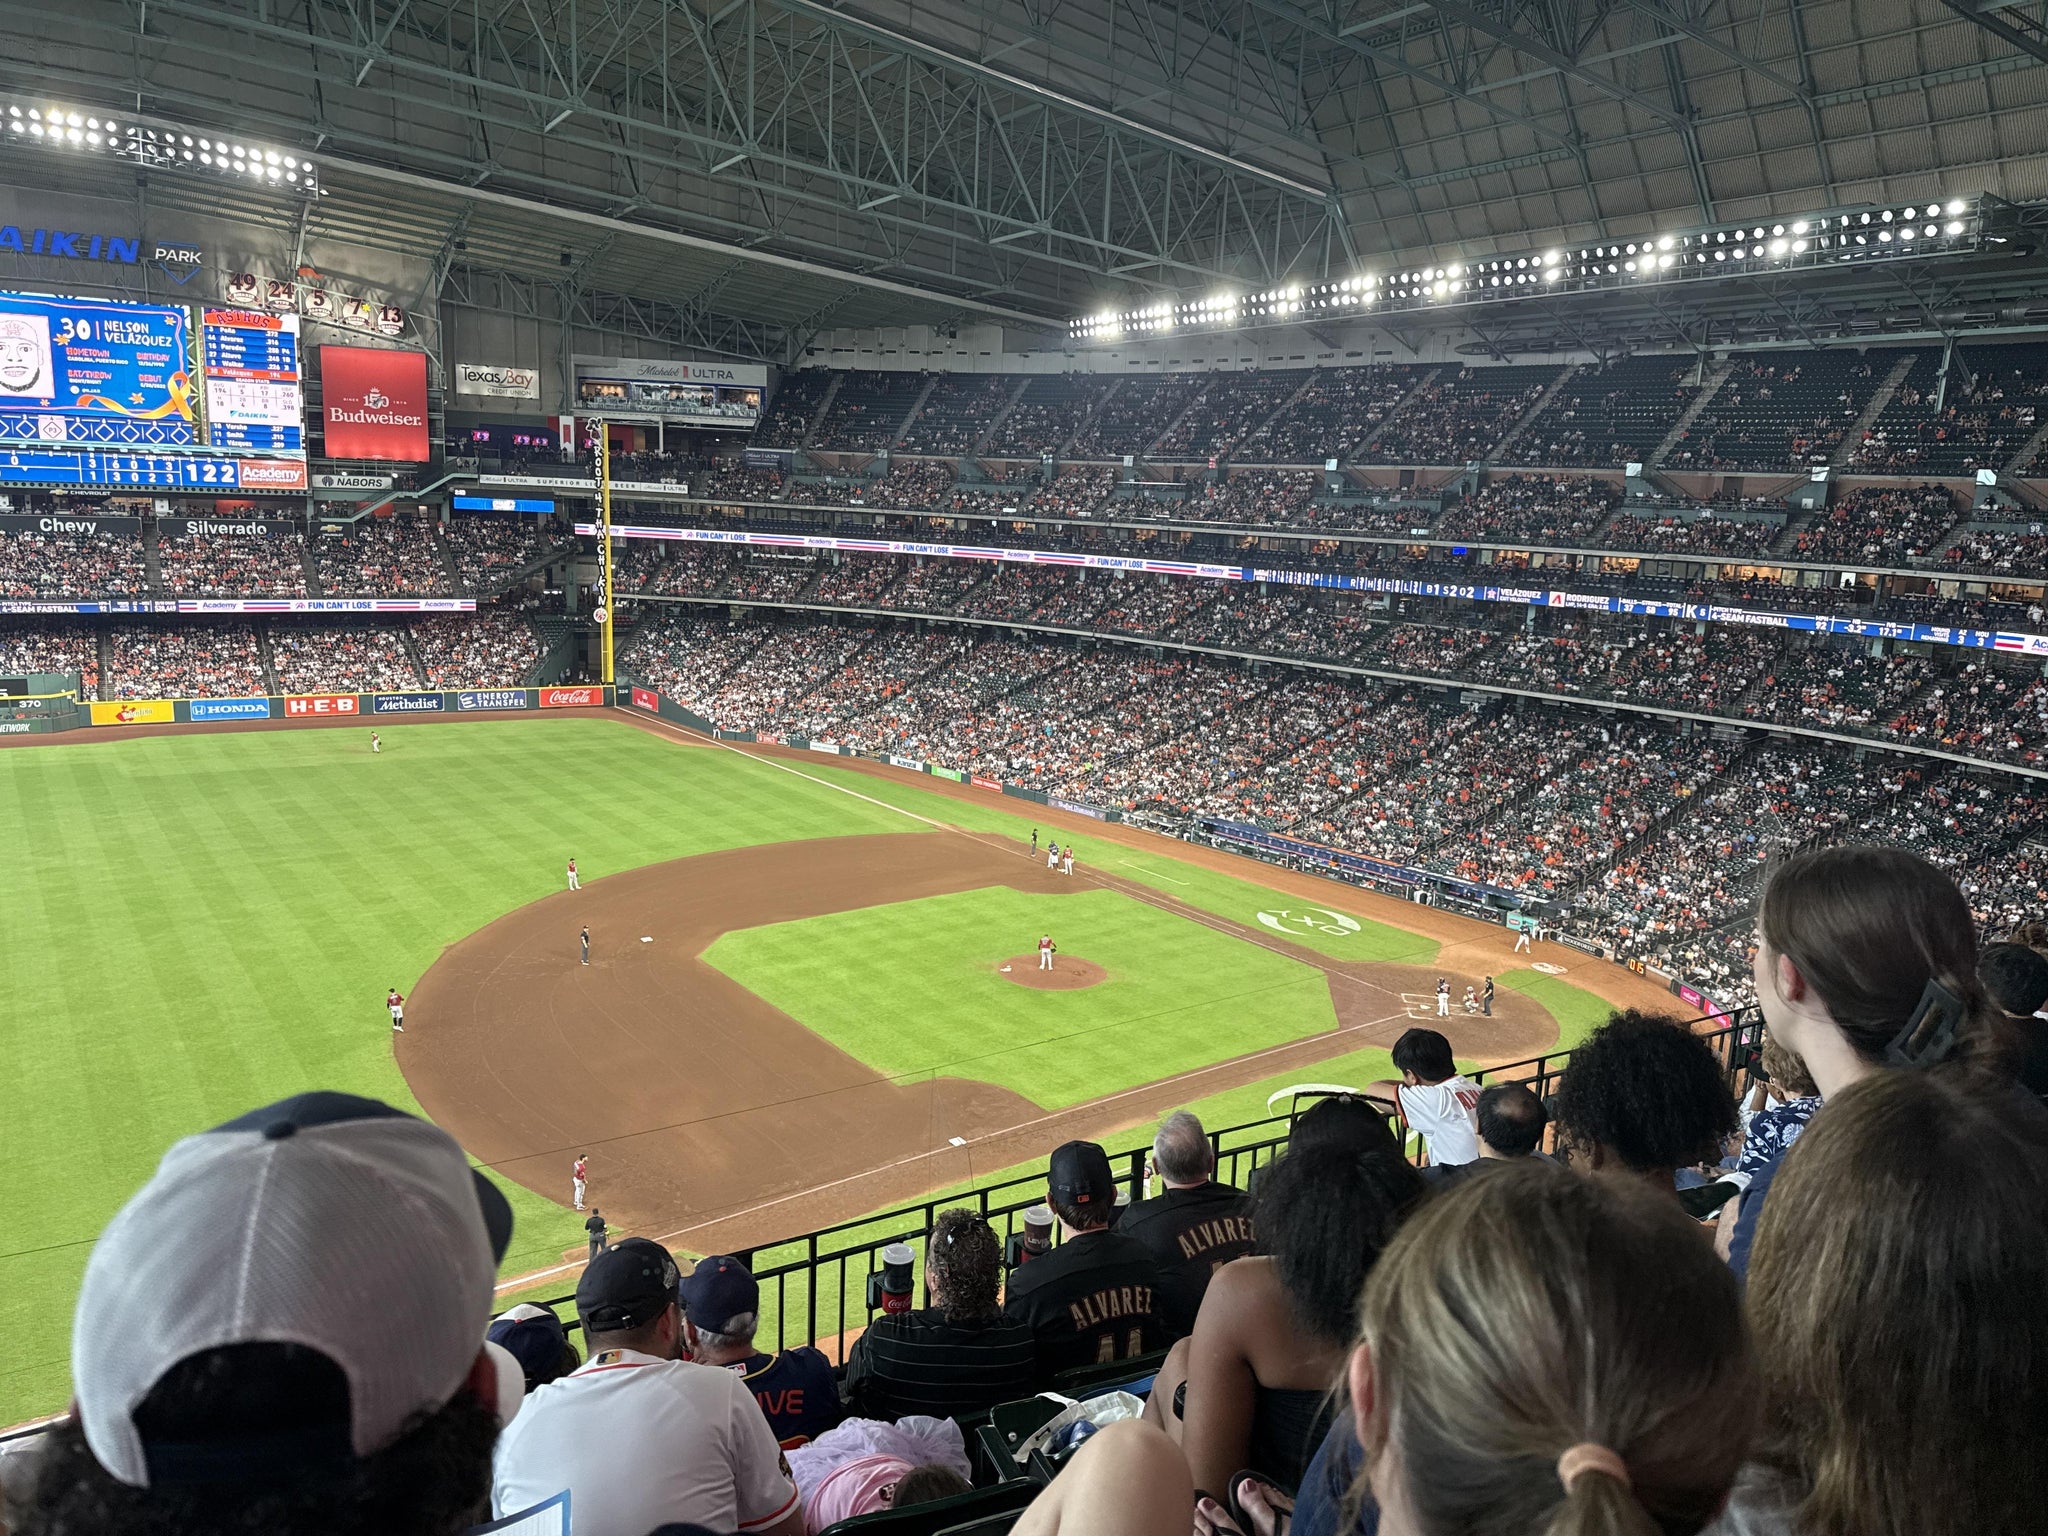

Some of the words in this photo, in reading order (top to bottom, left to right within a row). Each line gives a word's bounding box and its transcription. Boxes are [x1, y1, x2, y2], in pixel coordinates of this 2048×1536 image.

[155, 248, 202, 264] PARK
[230, 273, 256, 291] 49
[268, 281, 294, 300] 24
[314, 290, 325, 306] 5
[350, 299, 362, 314] 7
[216, 311, 270, 328] ASTROS
[380, 306, 402, 324] 13
[60, 318, 90, 340] 30
[104, 320, 149, 334] NELSON
[104, 332, 172, 347] VELÁZQUEZ
[66, 347, 110, 358] HOMETOWN
[136, 352, 170, 361] BIRTHDAY
[68, 370, 112, 380] BAT/THROW
[139, 374, 162, 382] DEBUT
[461, 366, 500, 382] Texas
[503, 369, 533, 389] Bay
[637, 364, 679, 378] Michelob
[692, 370, 734, 380] ULTRA
[487, 387, 508, 395] CREDIT
[11, 455, 19, 465] 0
[89, 459, 96, 468] 3
[112, 460, 120, 470] 6
[131, 461, 138, 470] 0
[150, 461, 155, 470] 1
[166, 462, 173, 471] 3
[594, 446, 603, 487] ROOT
[90, 471, 96, 480] 1
[113, 472, 121, 481] 3
[131, 472, 139, 482] 0
[149, 473, 156, 483] 2
[166, 474, 174, 483] 3
[186, 464, 198, 482] 1
[203, 464, 217, 482] 2
[221, 464, 235, 483] 2
[242, 467, 300, 482] Academy
[337, 478, 383, 488] NABORS
[595, 492, 602, 504] 4
[39, 518, 96, 535] Chevy
[187, 521, 267, 535] Silverado
[808, 538, 832, 546] Academy
[1007, 551, 1030, 559] Academy
[1109, 559, 1127, 567] CAN'T
[597, 545, 606, 606] CHIKIN
[1200, 566, 1224, 575] Academy
[1500, 588, 1541, 599] VELÁZQUEZ
[1566, 594, 1609, 605] RODRIGUEZ
[1668, 608, 1678, 616] 95
[1686, 604, 1697, 618] K
[1712, 612, 1744, 622] 4-SEAM
[1745, 615, 1789, 626] FASTBALL
[1816, 621, 1827, 630] 92
[1958, 636, 1964, 644] 3
[1977, 638, 1984, 647] 3
[478, 698, 524, 707] TRANSFER
[549, 689, 592, 704] Coca-Cola
[207, 704, 267, 714] HONDA
[379, 698, 438, 711] Methodist
[1564, 936, 1597, 952] WOODFOREST
[1177, 1216, 1257, 1260] ALVAREZ
[1068, 1286, 1152, 1332] ALVAREZ
